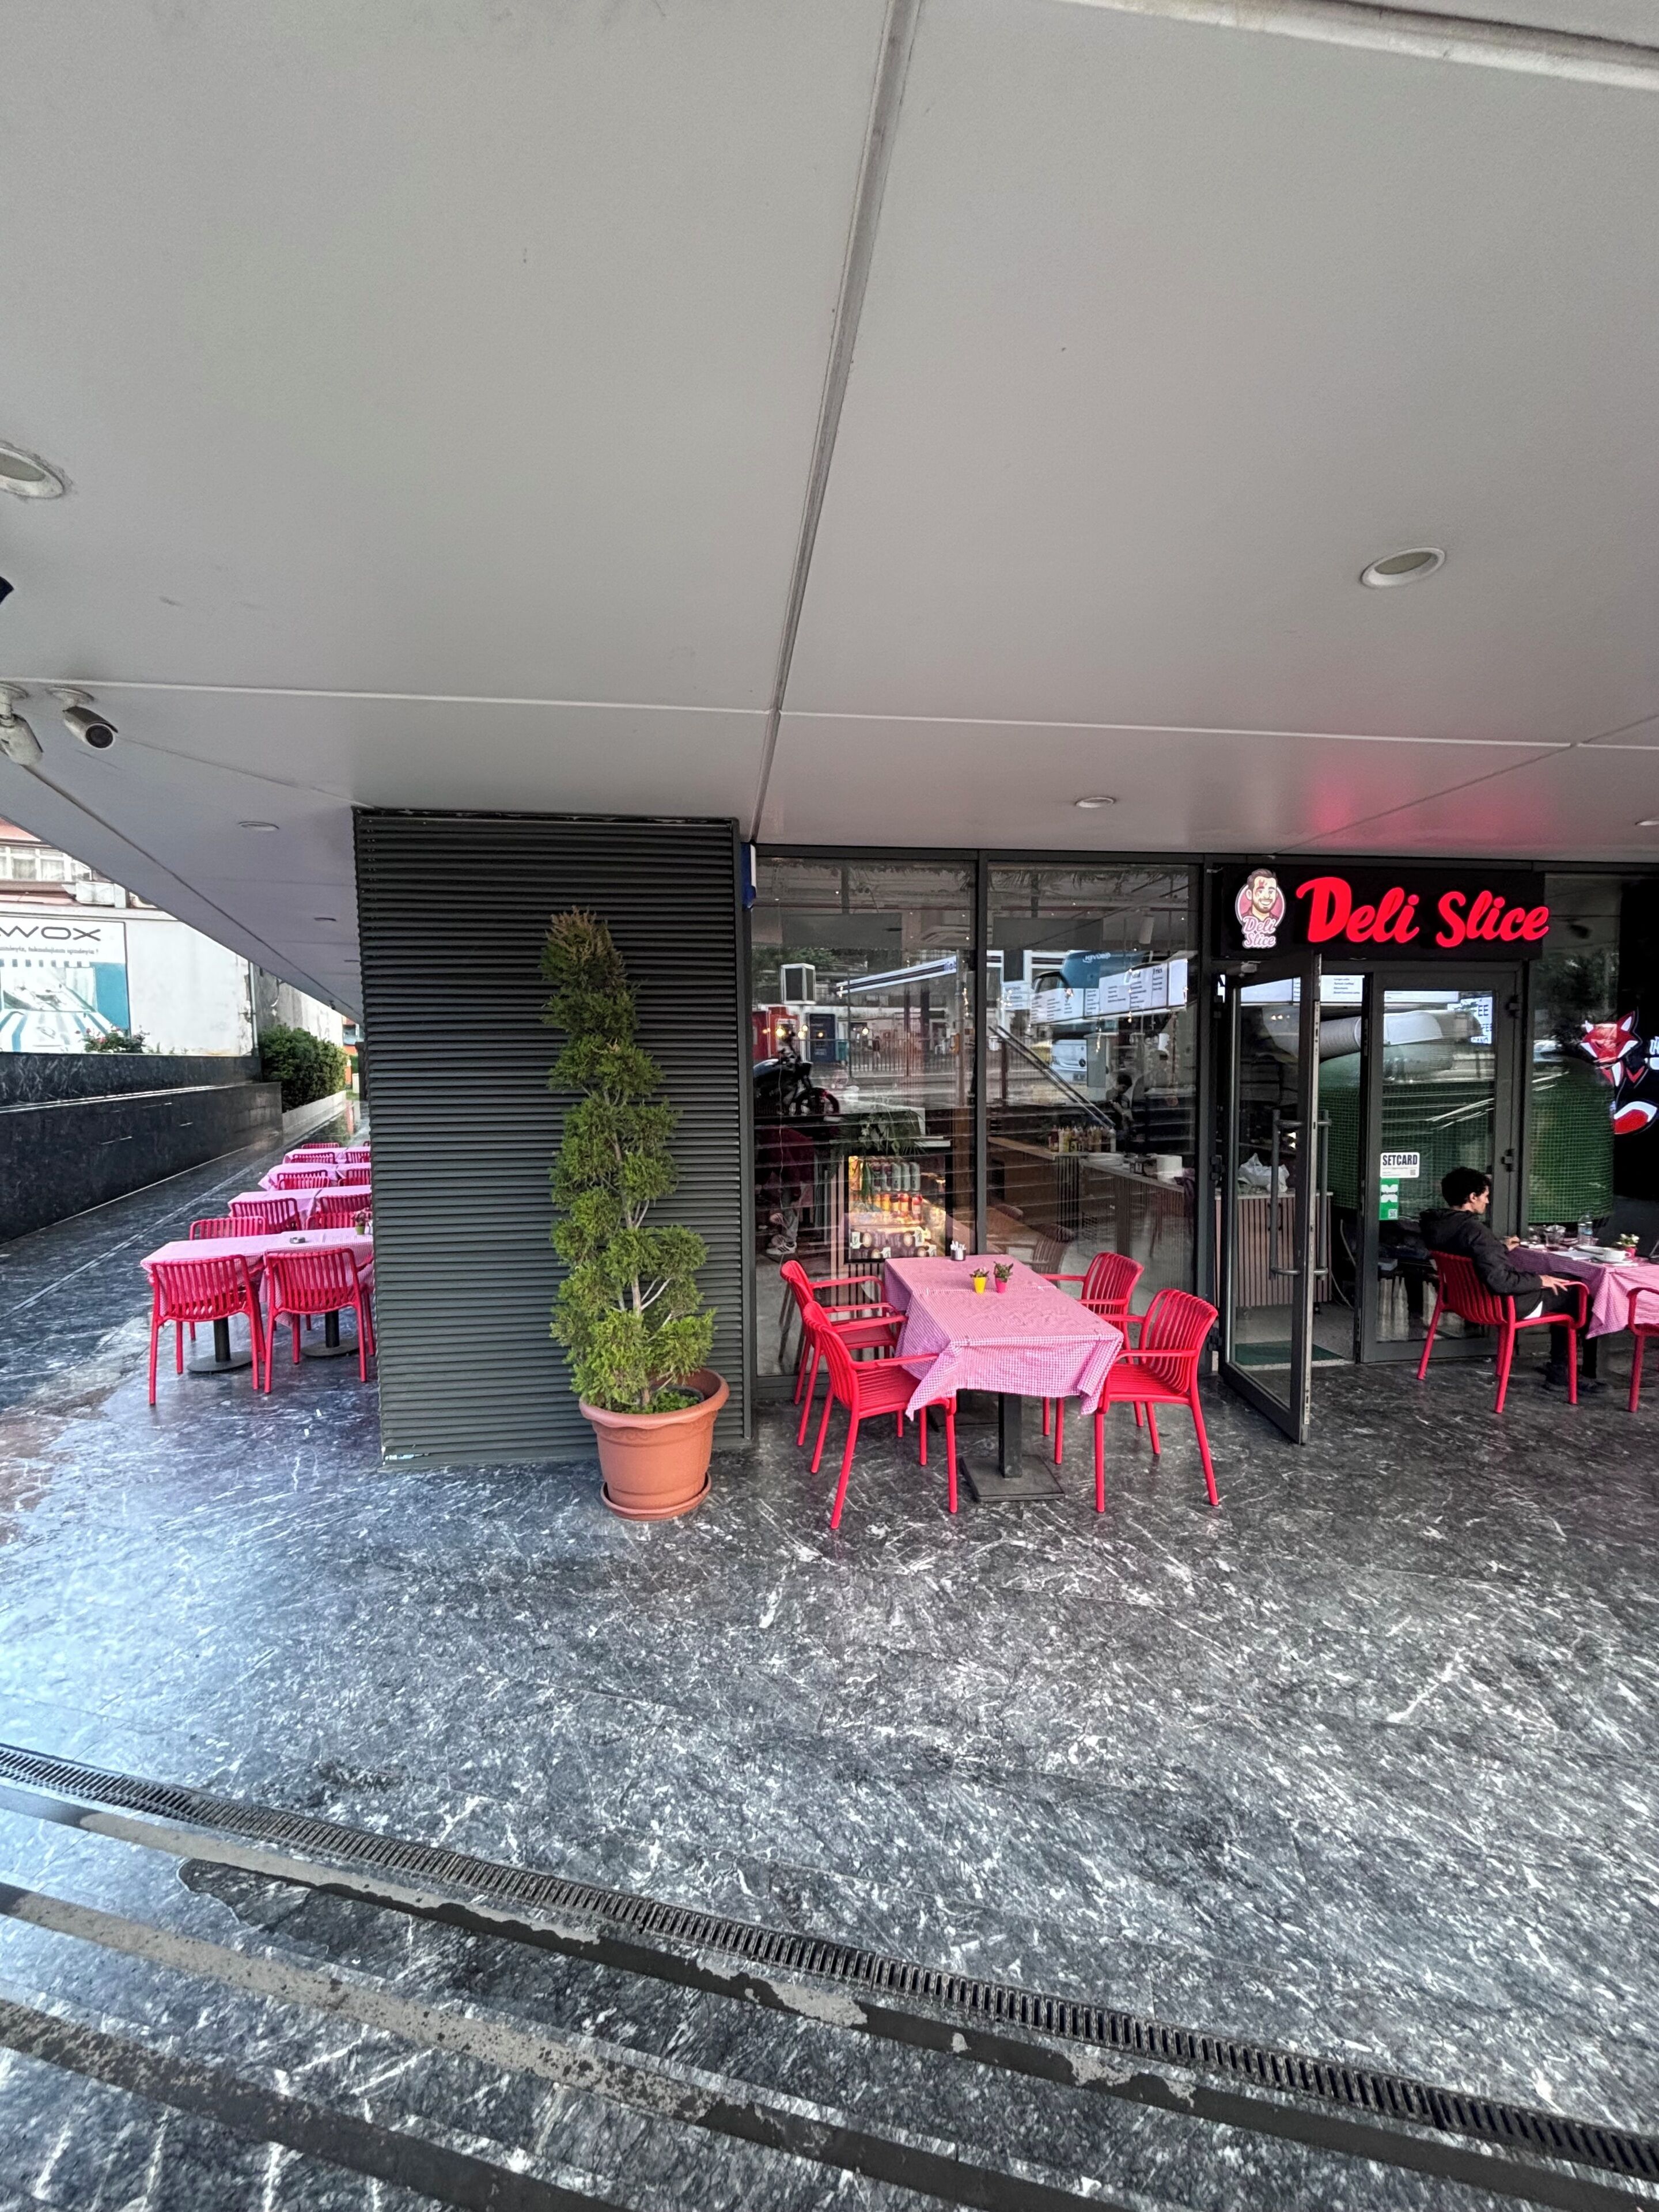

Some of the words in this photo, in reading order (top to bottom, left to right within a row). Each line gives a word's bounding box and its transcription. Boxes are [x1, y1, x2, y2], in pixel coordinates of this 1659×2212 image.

[1296, 876, 1419, 944] Deli
[1436, 890, 1550, 948] Slice
[0, 925, 101, 941] WOX
[1243, 916, 1276, 934] Deli
[1243, 933, 1276, 948] Slice
[1382, 1154, 1418, 1165] SETCARD
